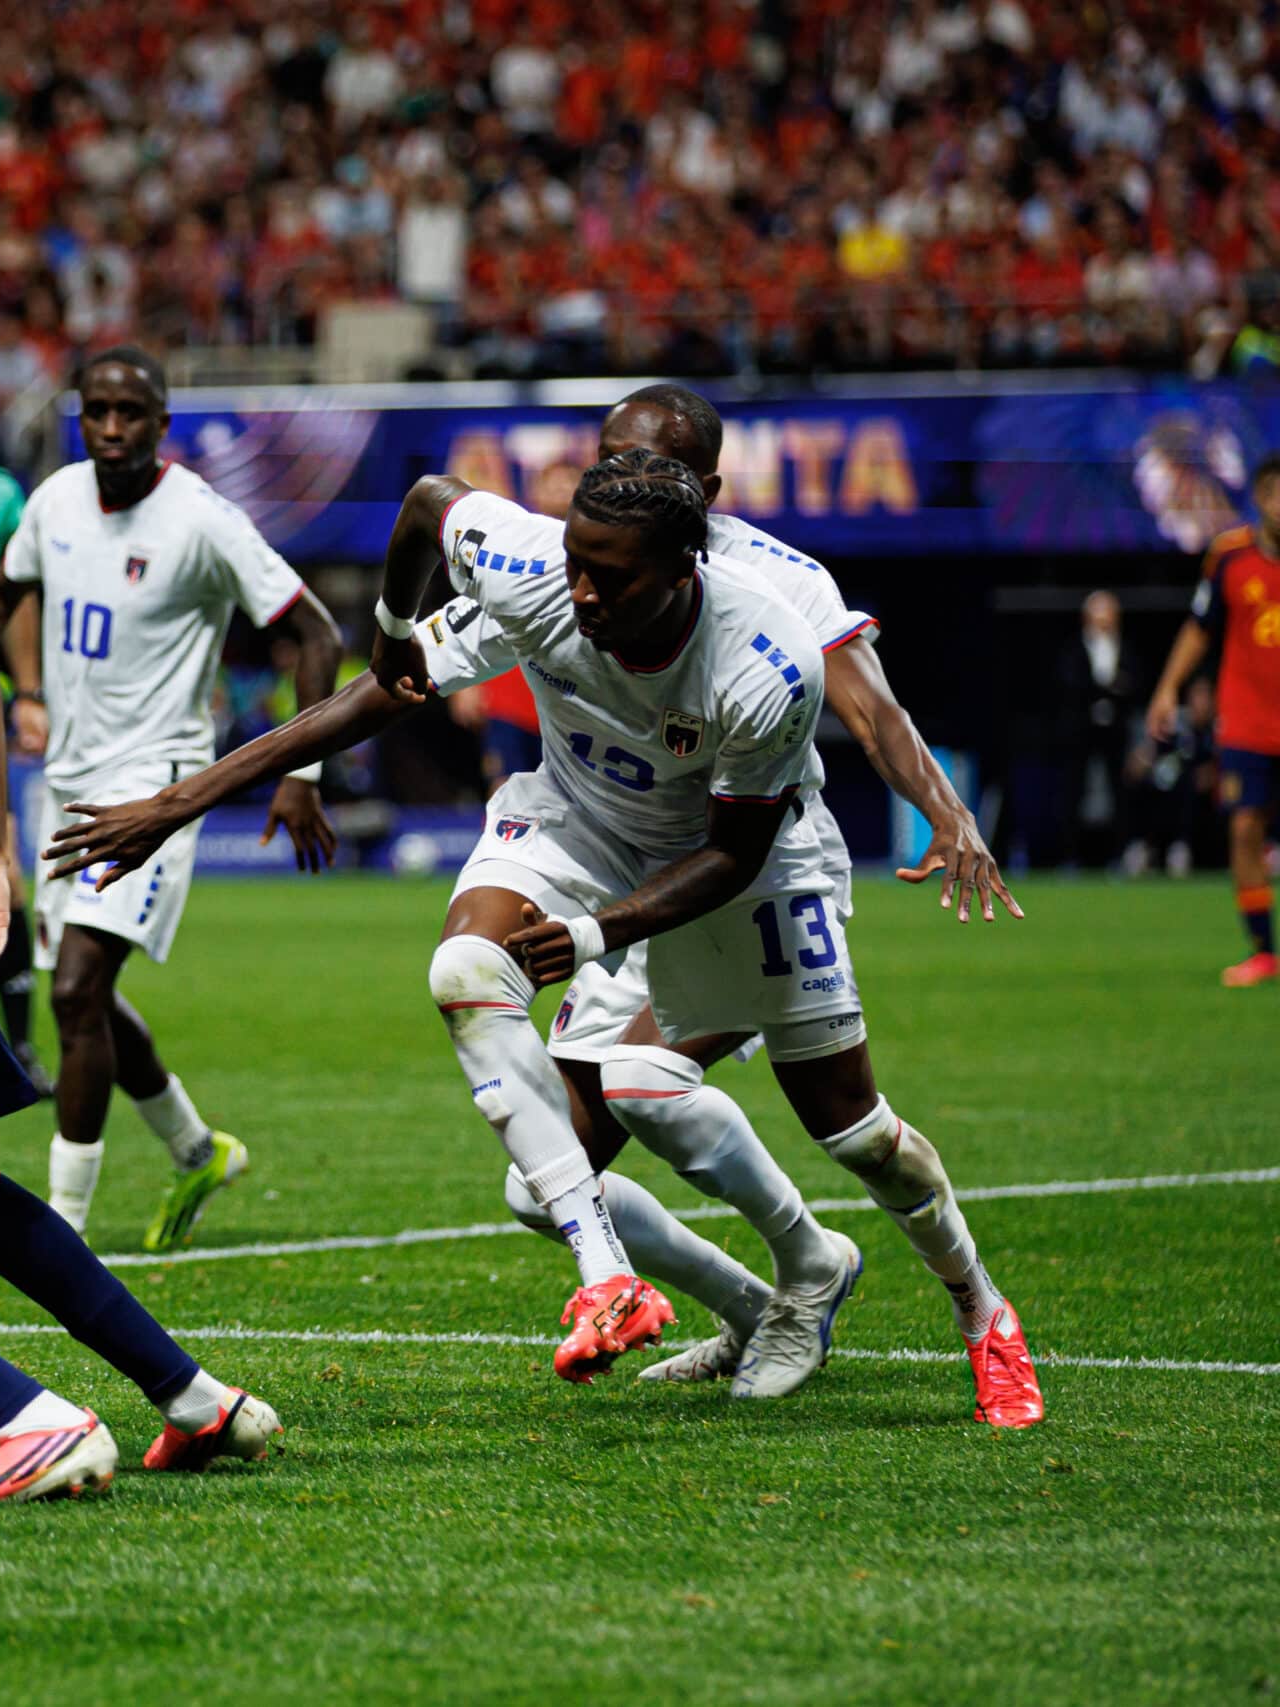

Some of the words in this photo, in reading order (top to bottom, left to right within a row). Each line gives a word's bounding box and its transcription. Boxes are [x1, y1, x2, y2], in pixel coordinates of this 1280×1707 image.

[63, 598, 113, 660] 10
[528, 660, 577, 696] capelli
[752, 893, 837, 976] 13
[802, 971, 845, 992] capelli
